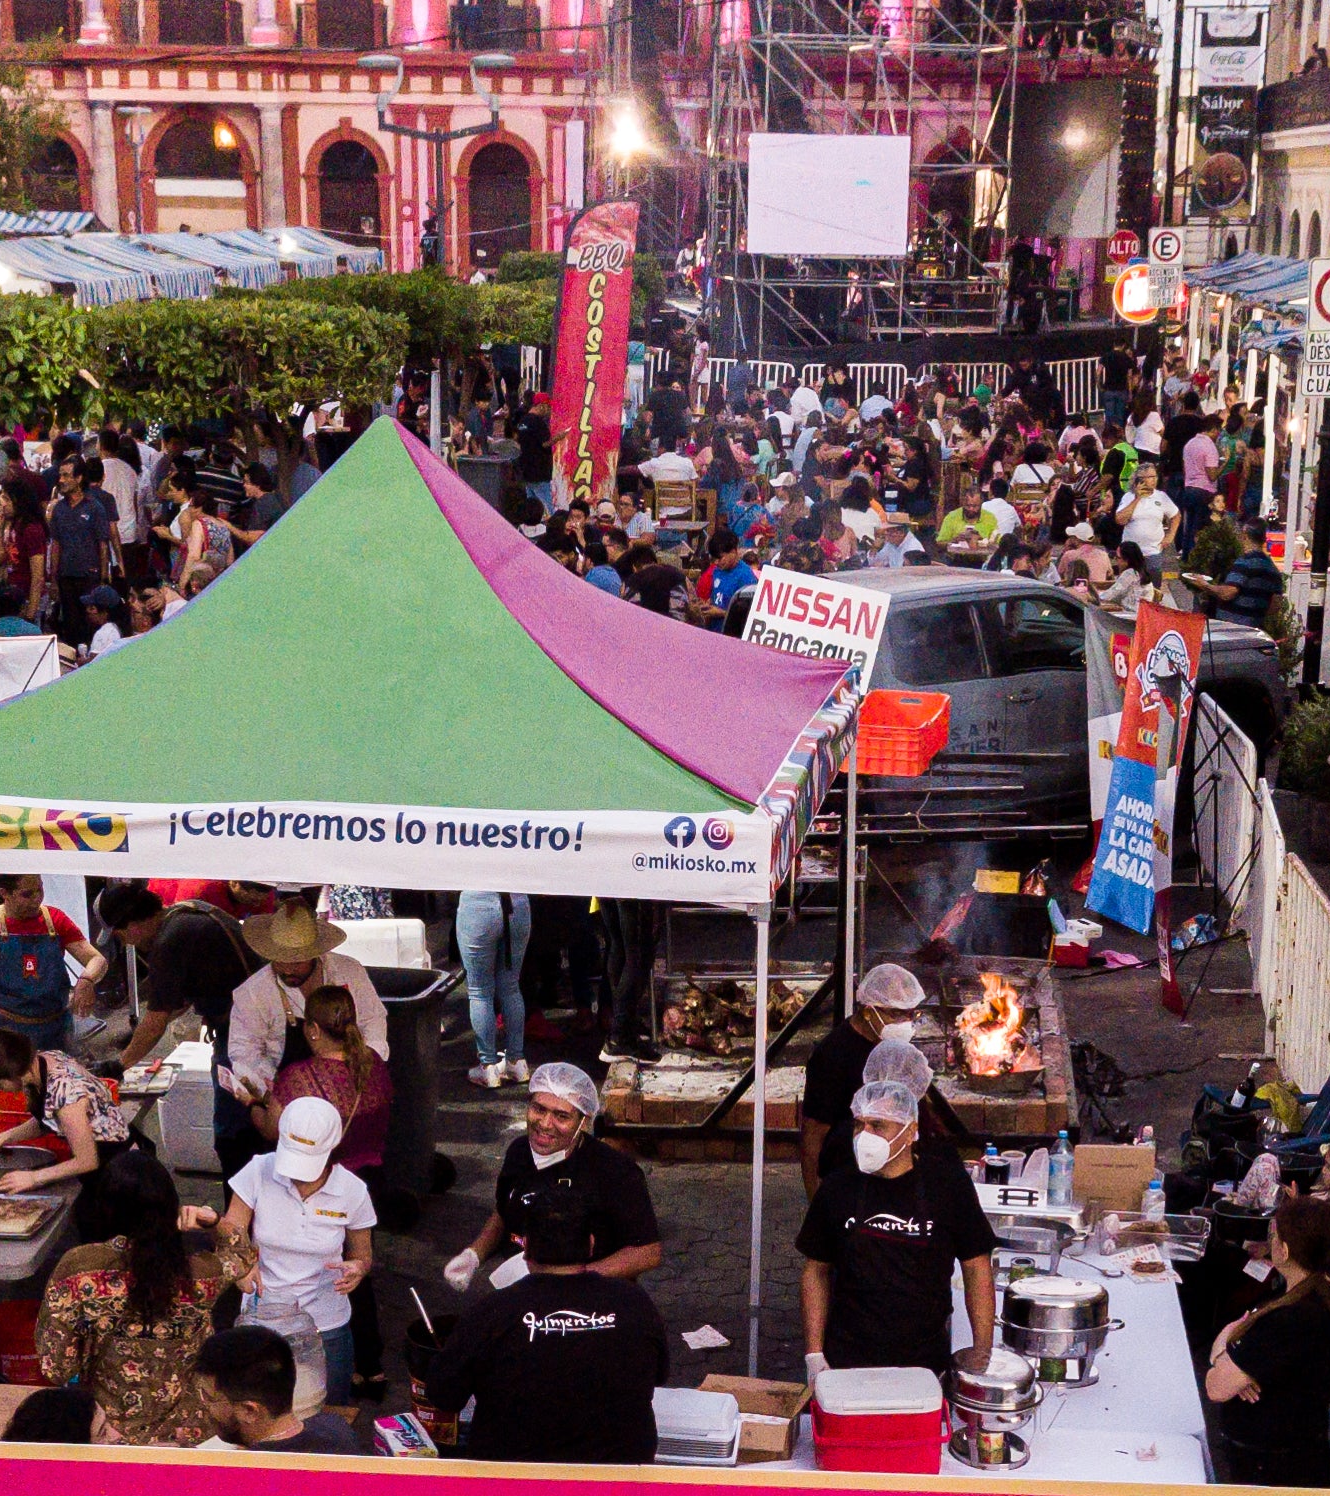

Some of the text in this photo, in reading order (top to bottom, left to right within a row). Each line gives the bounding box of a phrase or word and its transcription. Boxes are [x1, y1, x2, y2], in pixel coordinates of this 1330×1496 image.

[578, 243, 625, 273] BBQ
[1109, 239, 1139, 255] ALTO
[1160, 237, 1173, 256] E
[756, 579, 882, 640] NISSAN
[747, 618, 868, 673] Rancagua
[1115, 795, 1154, 823] AHOR
[169, 806, 585, 853] ¡Celebremos lo nuestro!
[1109, 829, 1154, 861] LA CAR
[632, 852, 757, 874] @mikiosko.mx
